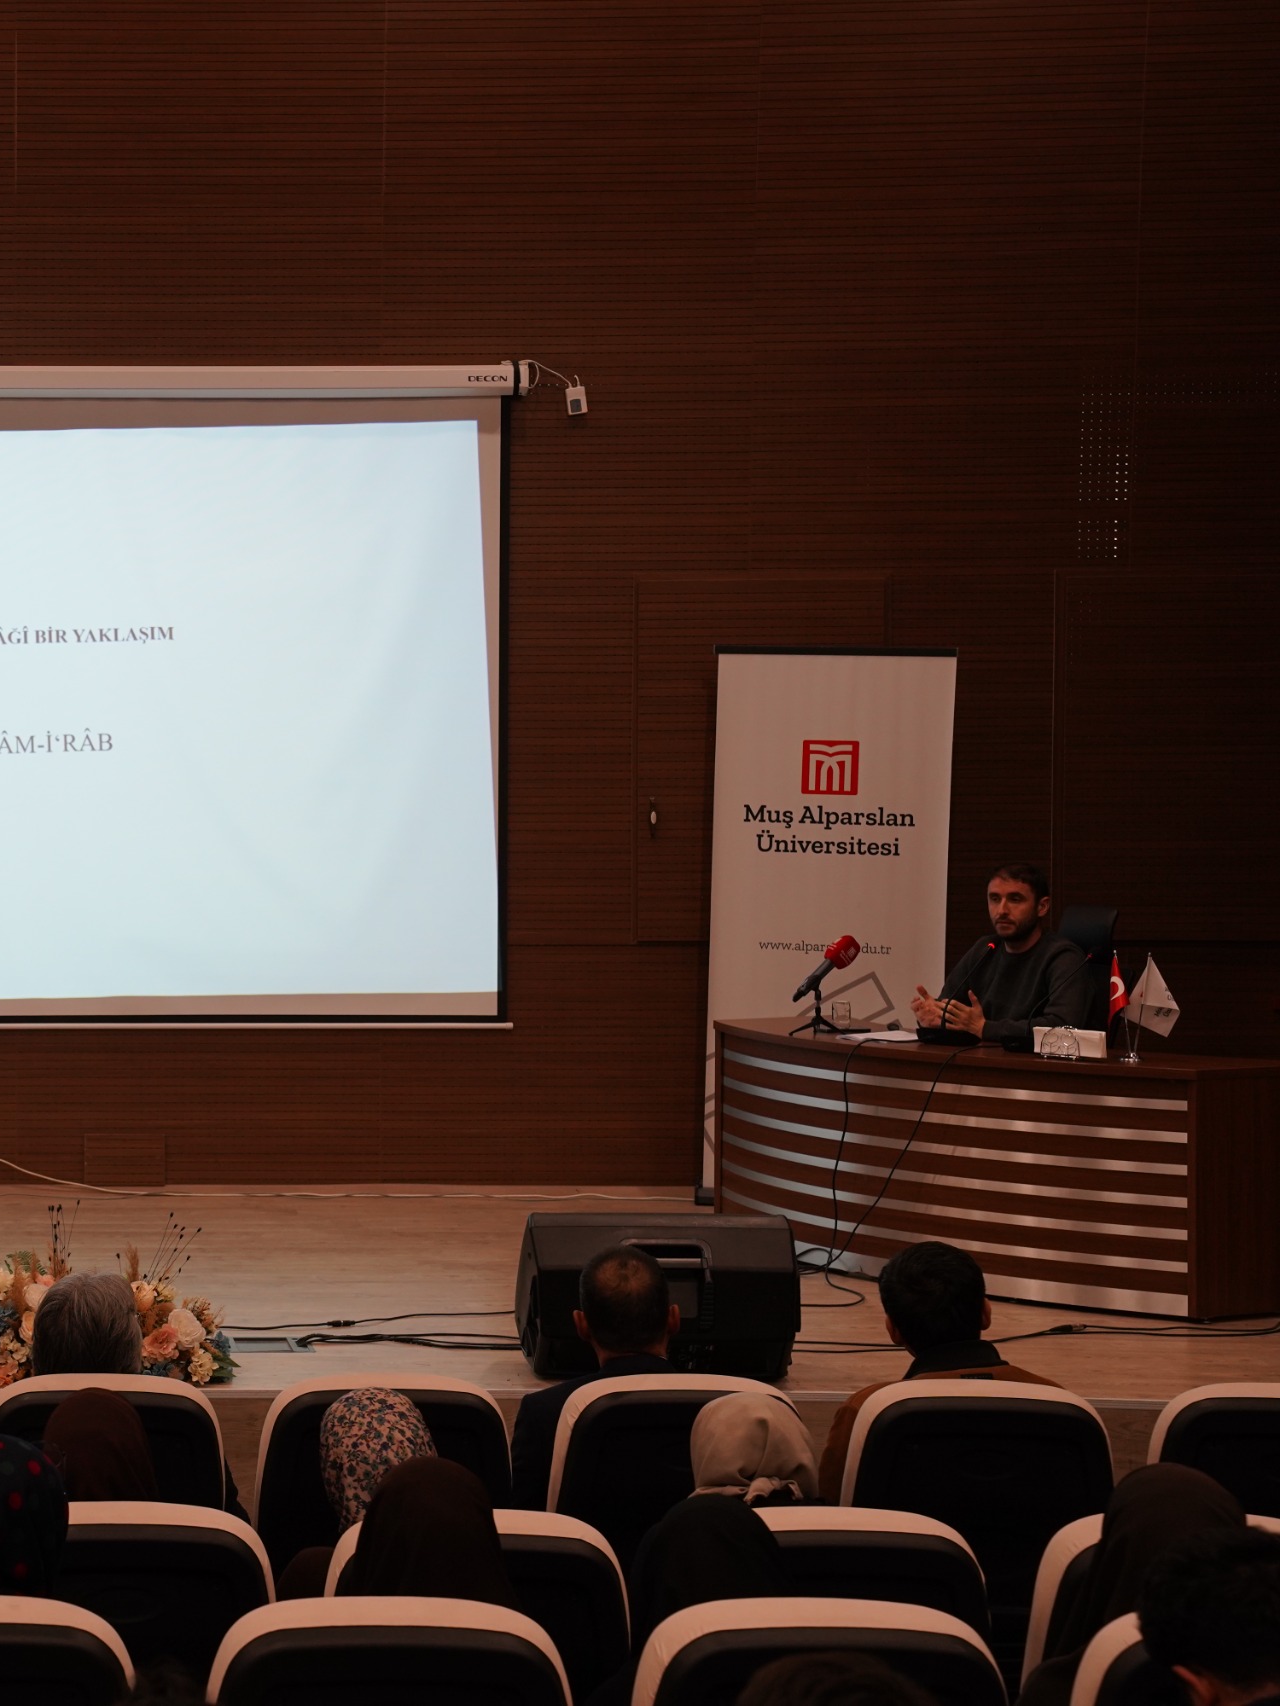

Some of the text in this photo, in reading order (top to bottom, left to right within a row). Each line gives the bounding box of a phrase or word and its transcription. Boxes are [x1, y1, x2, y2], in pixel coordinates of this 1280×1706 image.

[34, 626, 69, 644] BİR
[72, 626, 175, 644] YAKLAŞIM
[743, 804, 916, 830] Muş Alparslan
[756, 830, 900, 856] Üniversitesi
